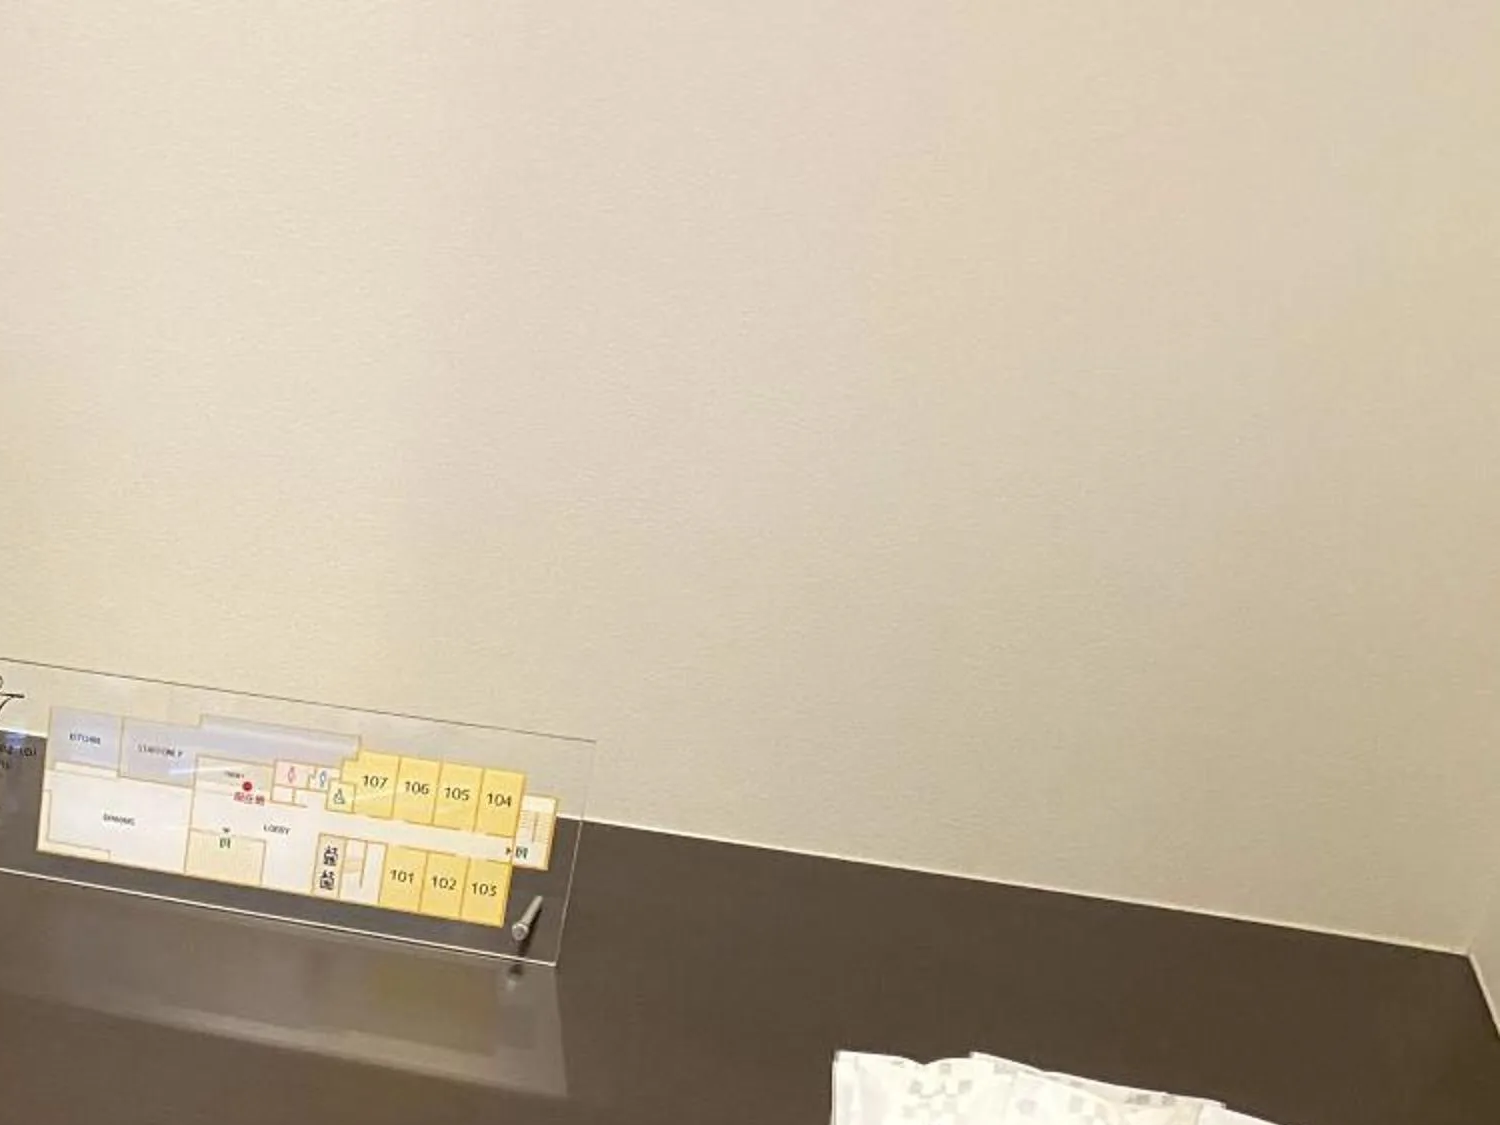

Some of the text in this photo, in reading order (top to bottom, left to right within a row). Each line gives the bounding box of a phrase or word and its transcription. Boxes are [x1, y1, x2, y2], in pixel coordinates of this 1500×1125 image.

[362, 775, 389, 790] 107
[404, 781, 430, 796] 106
[444, 786, 470, 802] 105
[486, 793, 512, 808] 104
[263, 823, 291, 835] LOBBY
[390, 869, 415, 885] 101
[431, 876, 457, 891] 102
[471, 882, 497, 897] 103
